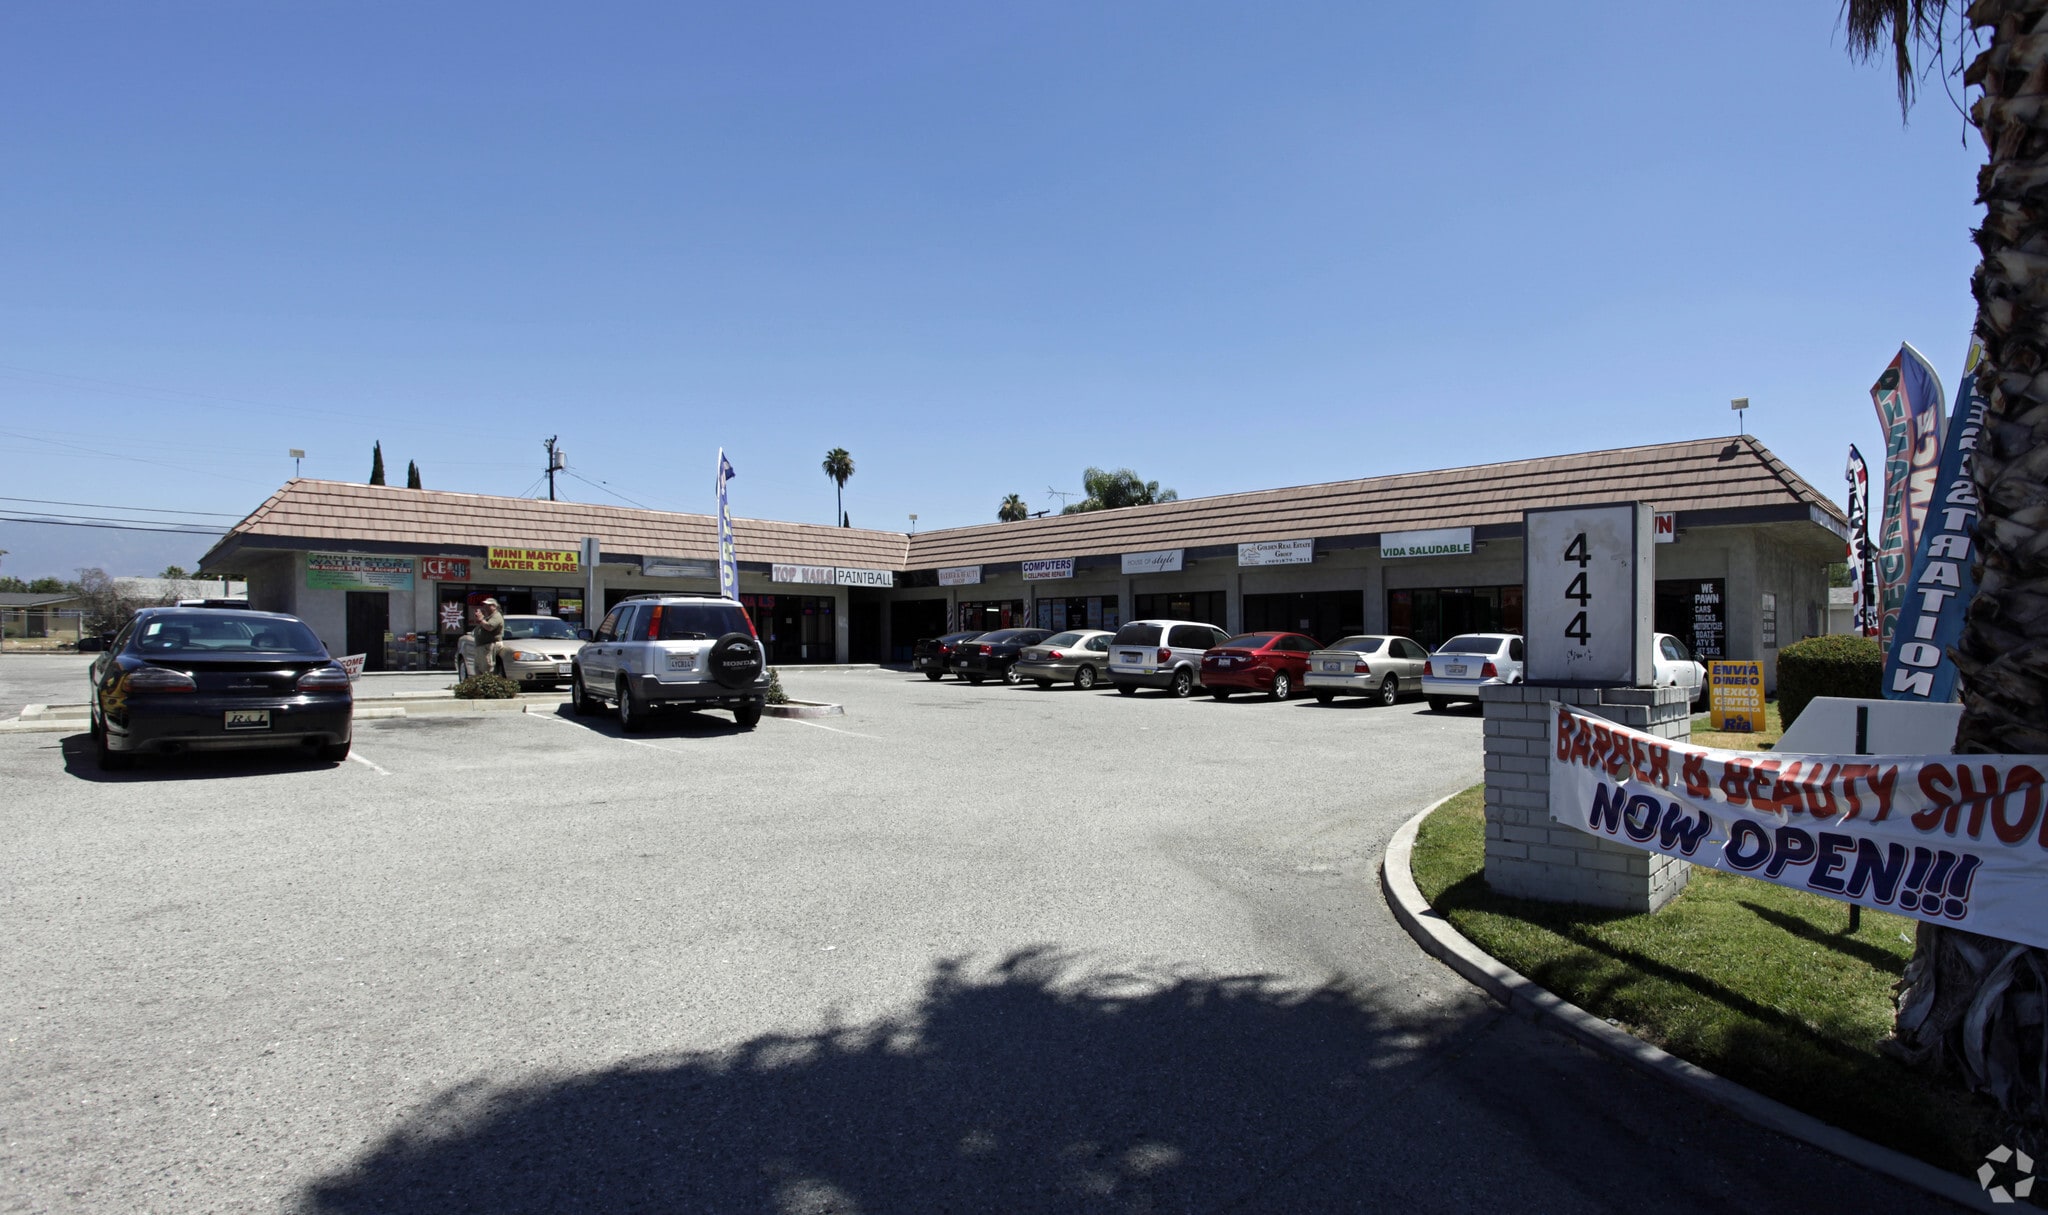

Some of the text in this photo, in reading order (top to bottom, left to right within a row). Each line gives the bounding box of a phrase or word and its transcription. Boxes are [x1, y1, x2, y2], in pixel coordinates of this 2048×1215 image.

[493, 549, 573, 561] MINI MART &
[1383, 544, 1470, 556] VIDA SALUDABLE
[309, 558, 361, 566] WATER
[422, 559, 446, 574] ICE
[490, 559, 577, 572] WATER STORE
[1023, 559, 1071, 571] COMPUTERS
[1152, 552, 1174, 571] style
[774, 566, 833, 585] TOP NAILS
[838, 570, 892, 586] PAINTBALL
[1701, 584, 1713, 593] WE
[1695, 594, 1719, 604] PAWN
[1696, 647, 1720, 655] JET SKIS
[1713, 665, 1759, 675] ENVIA
[1713, 677, 1759, 685] DINERO
[1713, 687, 1759, 697] MEXICO,
[1714, 697, 1759, 706] CENTRO
[1725, 714, 1752, 730] Ria
[1557, 709, 2048, 848] BARBER & BEAUTY SHO
[1589, 782, 1983, 920] NOW OPEN!!!
